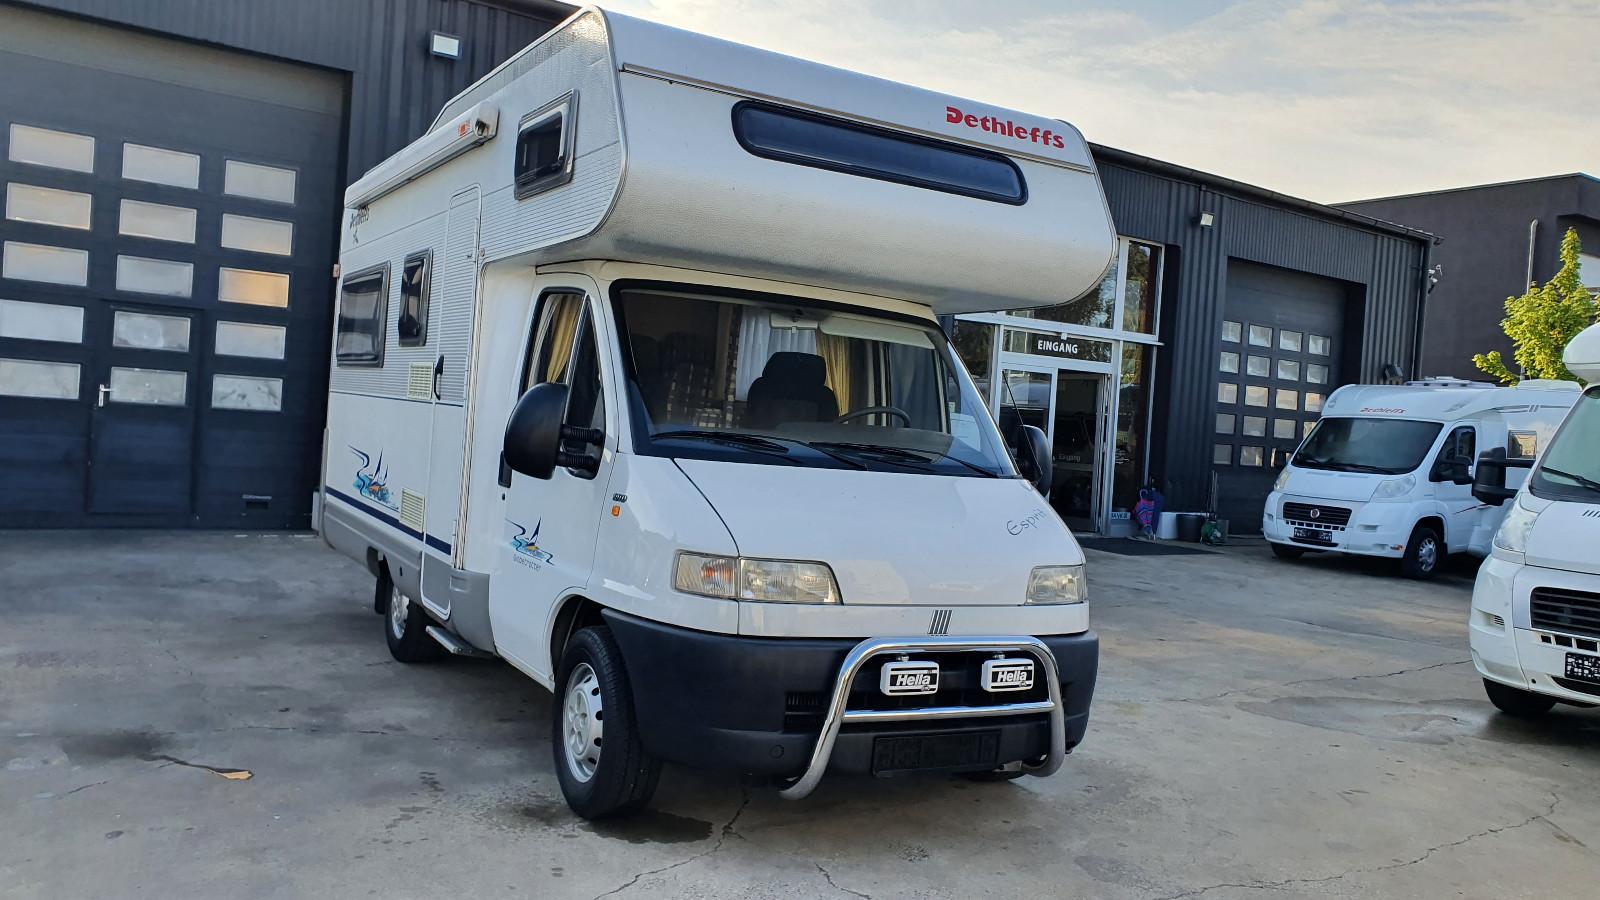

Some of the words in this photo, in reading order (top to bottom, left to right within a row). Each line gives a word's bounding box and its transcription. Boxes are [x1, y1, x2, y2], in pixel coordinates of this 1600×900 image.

[946, 106, 1065, 149] Dethleffs
[1037, 340, 1078, 354] EINGANG
[1007, 508, 1047, 536] Esprit
[896, 673, 931, 686] Hella
[996, 670, 1028, 683] Hella
